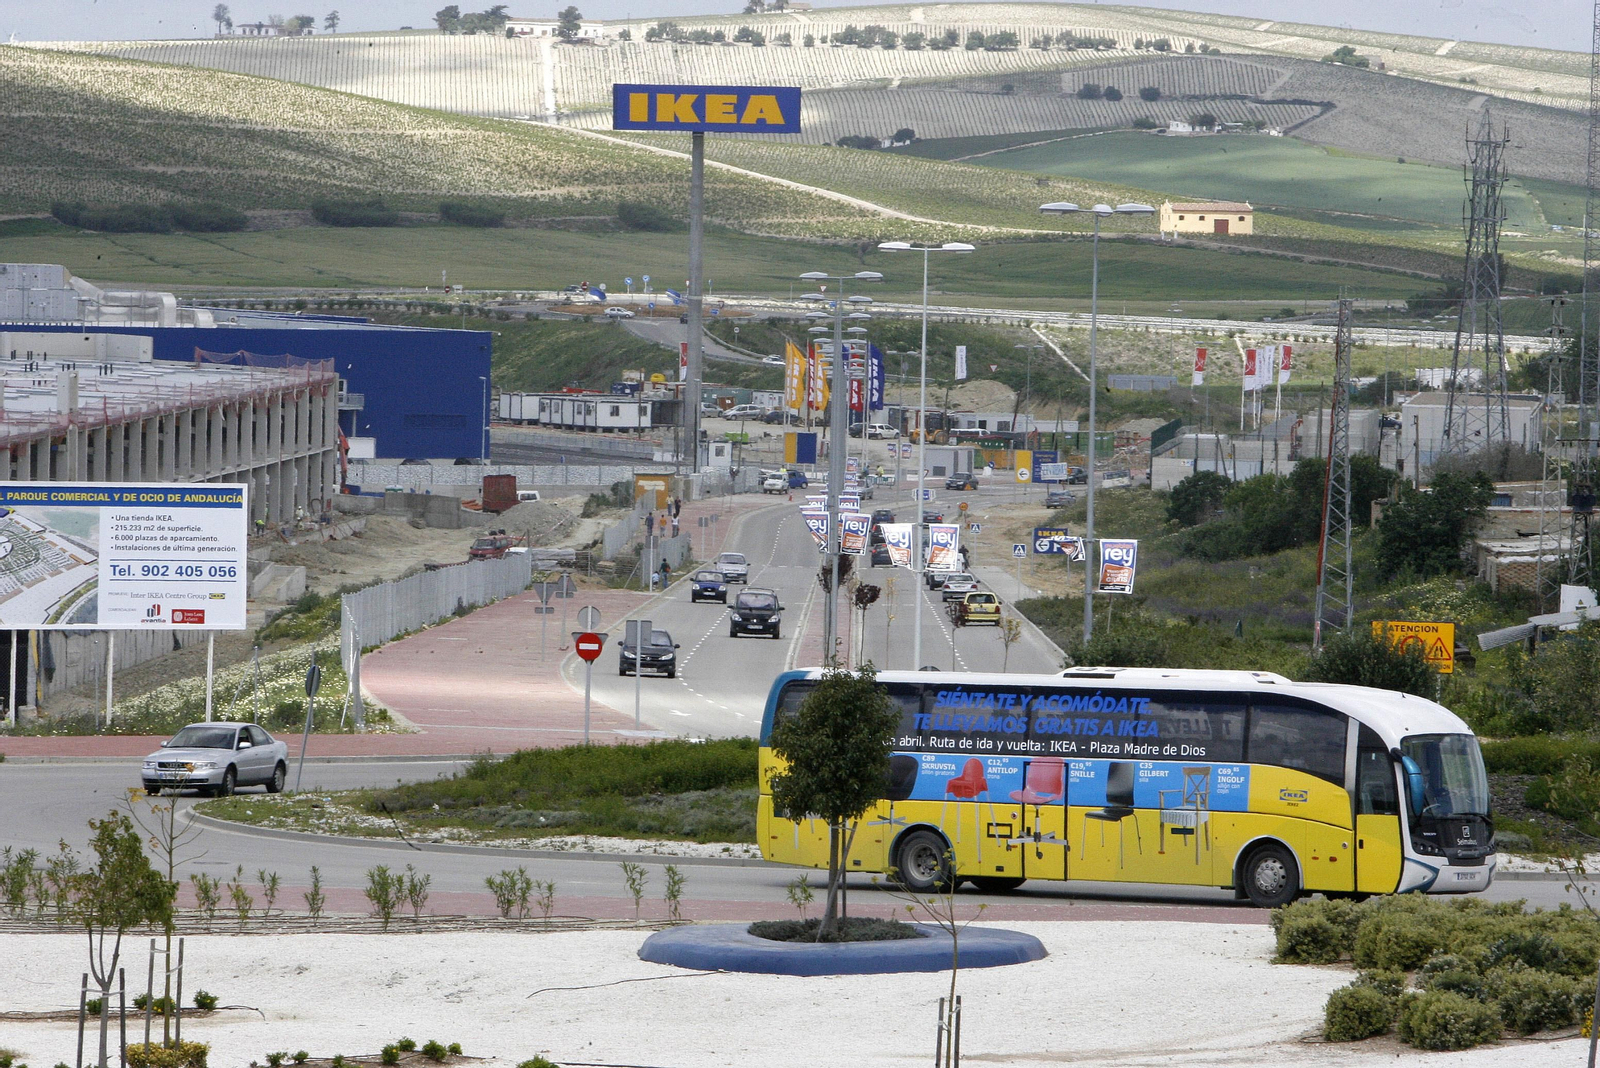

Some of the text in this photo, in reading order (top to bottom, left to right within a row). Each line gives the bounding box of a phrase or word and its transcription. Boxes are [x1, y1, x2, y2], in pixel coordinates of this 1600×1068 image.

[629, 92, 785, 125] IKEA
[871, 358, 880, 402] IKEA
[7, 492, 48, 501] PARQUE
[51, 492, 111, 502] COMERCIAL
[113, 493, 120, 502] Y
[123, 493, 137, 502] DE
[140, 493, 164, 502] OCIO
[167, 494, 181, 502] DE
[184, 492, 243, 503] ANDALUCÍA
[115, 514, 130, 522] Una
[131, 514, 154, 522] tienda
[115, 524, 142, 532] 215.233
[157, 524, 166, 532] de
[167, 524, 203, 534] superficie.
[845, 521, 868, 536] rey
[114, 534, 134, 542] 6.000
[135, 534, 159, 544] plazas
[170, 535, 220, 545] aparcamiento.
[933, 532, 956, 549] rey
[114, 544, 161, 552] Instalaciones
[172, 544, 196, 552] última
[197, 545, 238, 555] generación.
[1104, 548, 1134, 567] rey
[110, 564, 237, 578] Tel. 902 405 056
[165, 592, 186, 600] Centre
[187, 593, 207, 601] Group
[1389, 625, 1439, 633] ATENCION
[935, 687, 1017, 710] SIÉNTATE
[1021, 694, 1033, 711] Y
[913, 713, 1159, 737] TE LLEVAMOS GRATIS A IKEA
[899, 735, 926, 747] abril.
[929, 737, 955, 749] Ruta
[958, 738, 973, 749] de
[976, 738, 993, 749] ida
[996, 740, 1004, 751] y
[1006, 740, 1045, 751] vuelta:
[1049, 740, 1077, 753] IKEA
[1090, 741, 1120, 754] Plaza
[1124, 743, 1159, 755] Madre
[1162, 744, 1177, 756] de
[1180, 745, 1206, 756] Dios
[1070, 770, 1095, 778] SNILLE
